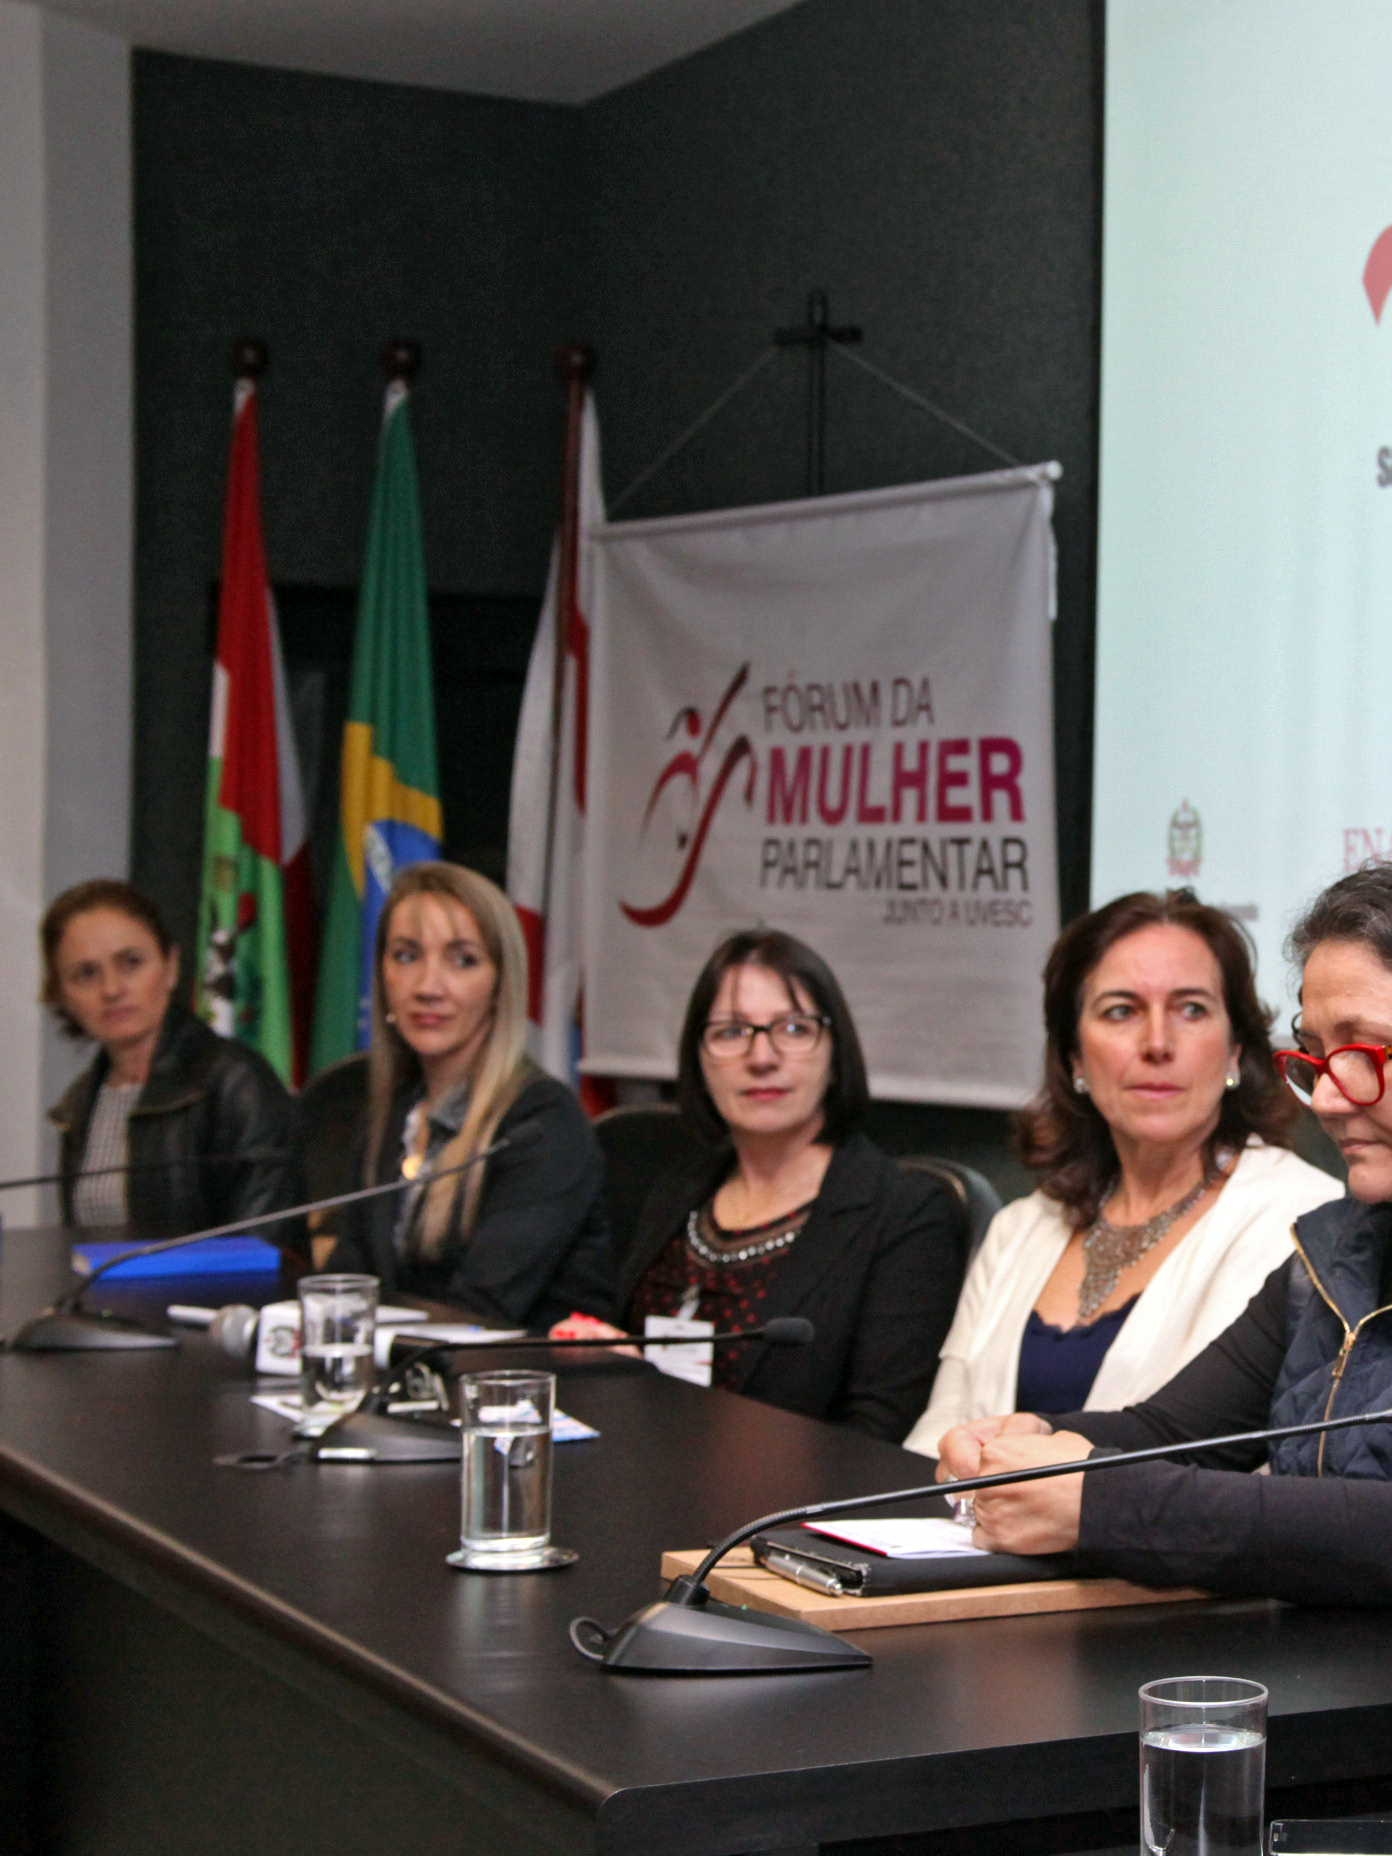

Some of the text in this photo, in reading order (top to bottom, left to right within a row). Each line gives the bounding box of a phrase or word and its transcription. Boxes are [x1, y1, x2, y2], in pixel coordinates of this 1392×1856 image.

[763, 669, 935, 734] FÓRUM DA
[765, 735, 1026, 826] MULHER
[760, 835, 1030, 892] PARLAMENTAR
